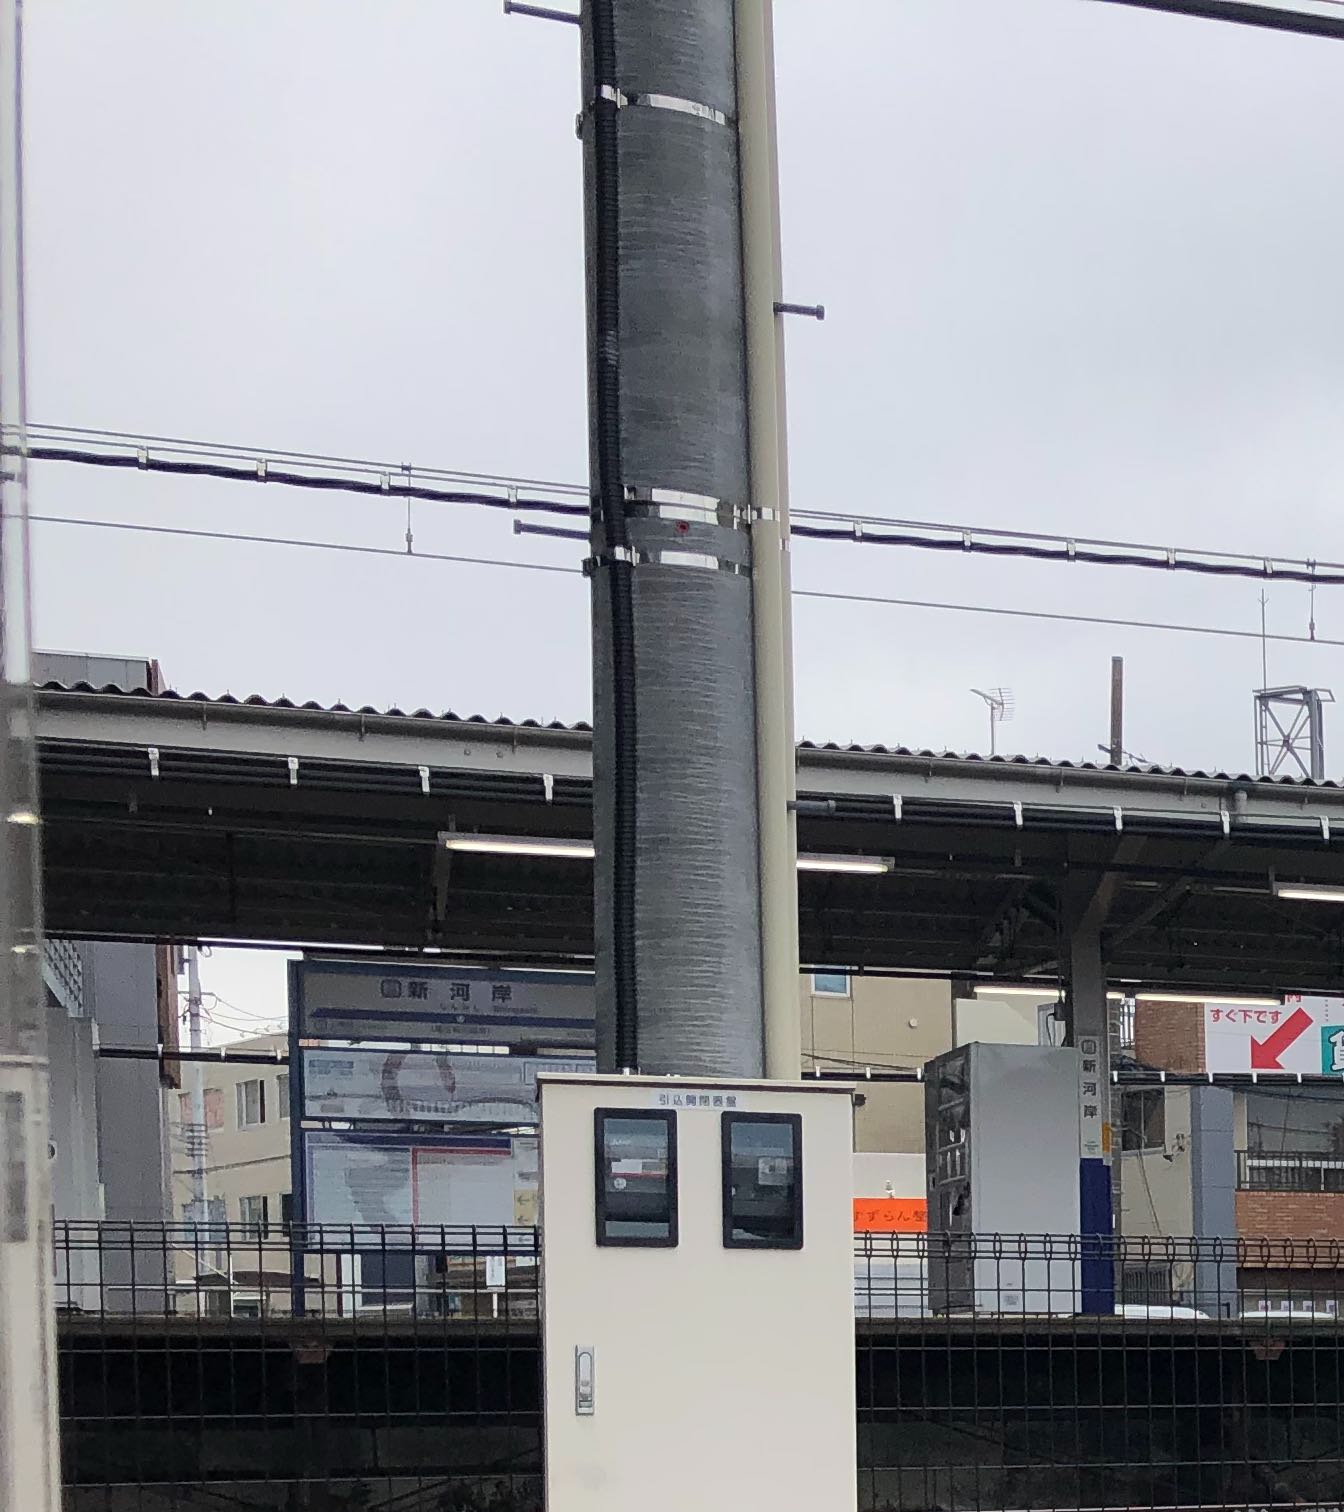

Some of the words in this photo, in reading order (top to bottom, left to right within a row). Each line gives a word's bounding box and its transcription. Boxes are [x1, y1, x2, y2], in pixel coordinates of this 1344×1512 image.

[1210, 1007, 1283, 1025] すぐ下です
